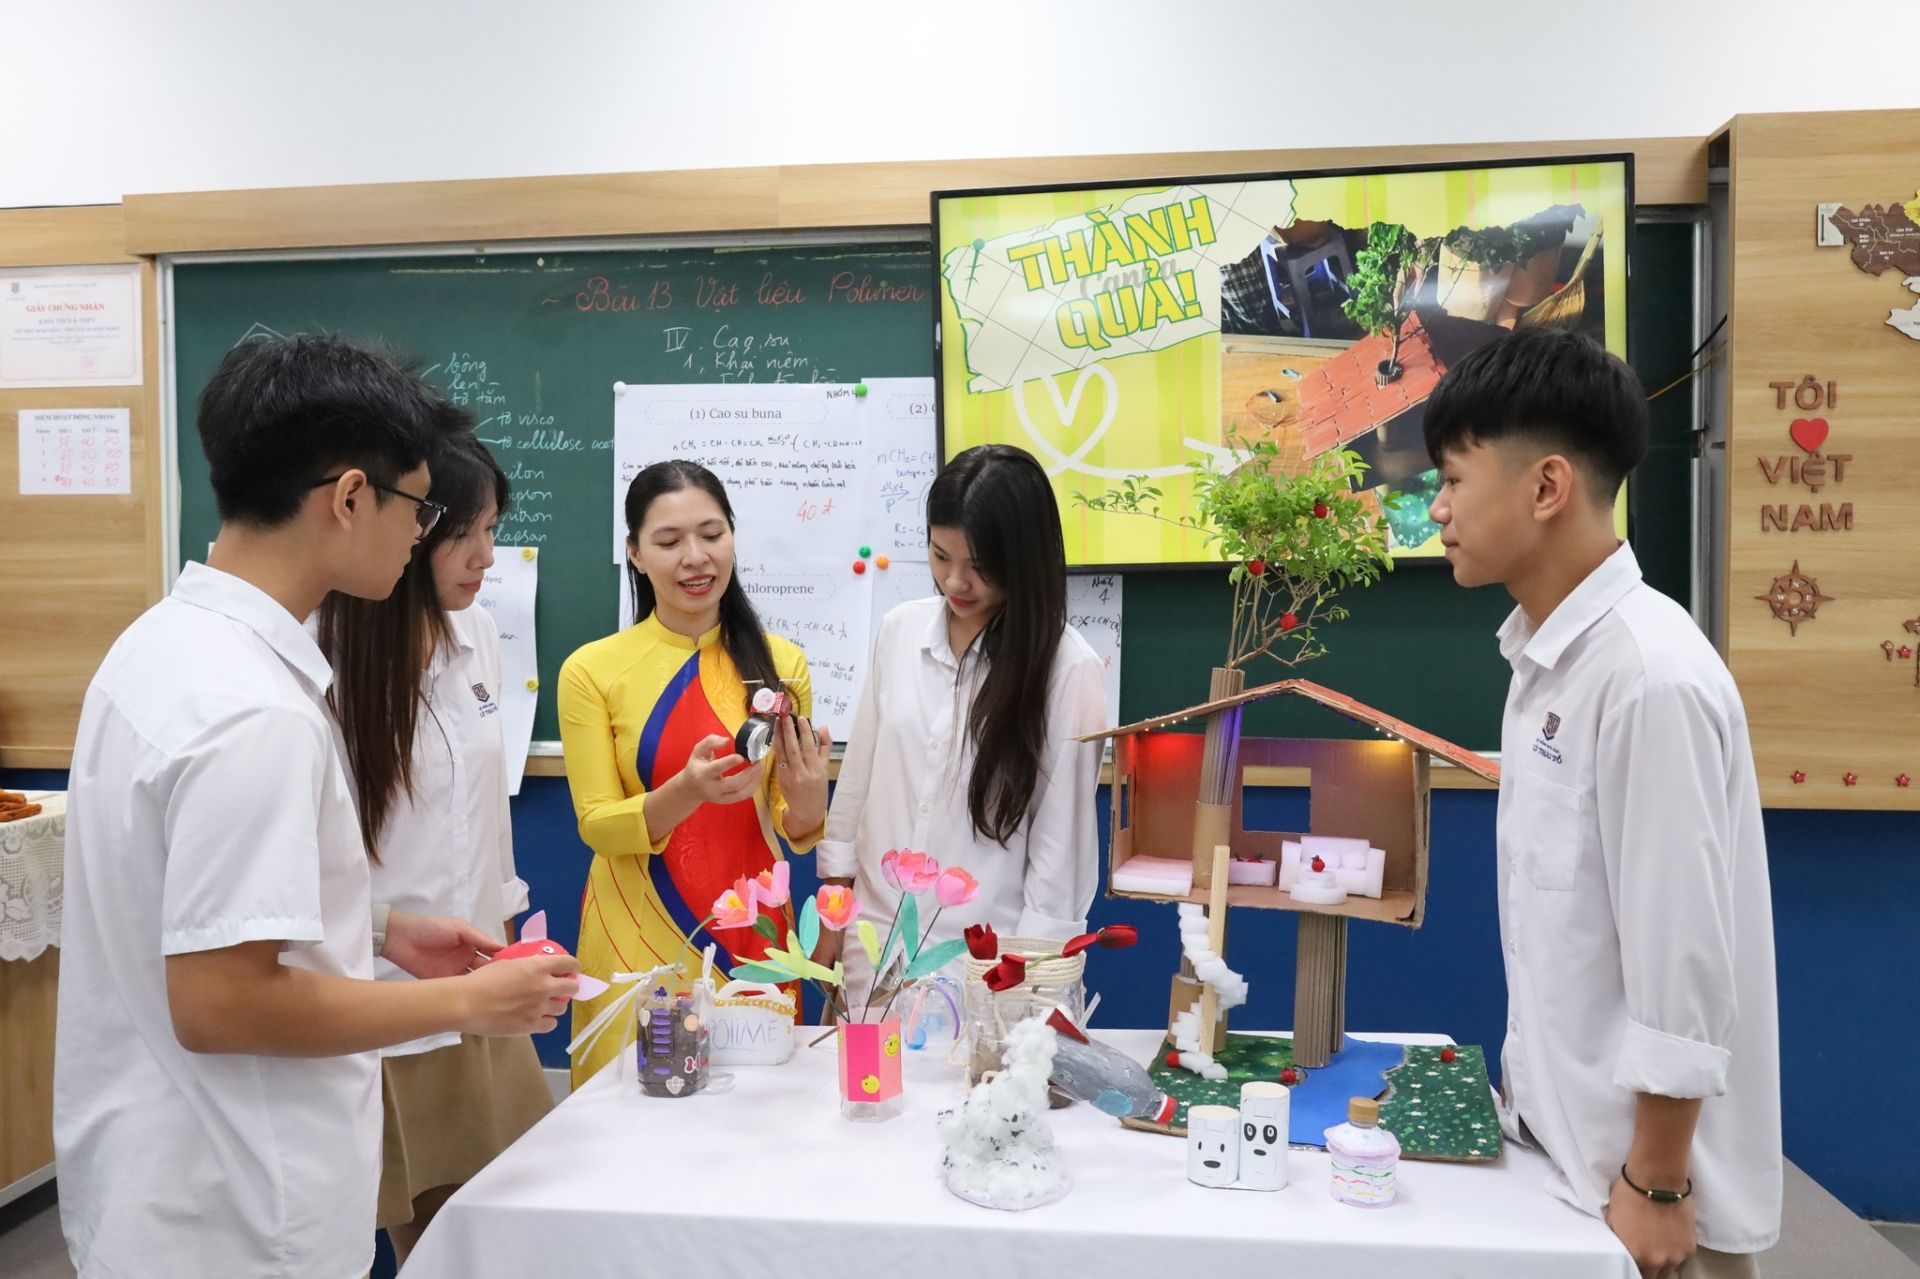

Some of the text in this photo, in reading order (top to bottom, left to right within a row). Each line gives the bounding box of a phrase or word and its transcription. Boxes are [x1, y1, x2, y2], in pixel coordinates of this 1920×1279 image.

[1006, 195, 1217, 292] THÀNH
[648, 280, 673, 309] 13
[1055, 258, 1204, 351] QUẢ!
[1769, 374, 1837, 411] TÔI
[690, 408, 782, 419] (1) Cao su buna
[909, 403, 928, 415] (2)
[508, 462, 544, 480] ilon
[1758, 451, 1853, 493] VIỆT
[797, 500, 817, 522] 40
[1761, 503, 1854, 532] NAM
